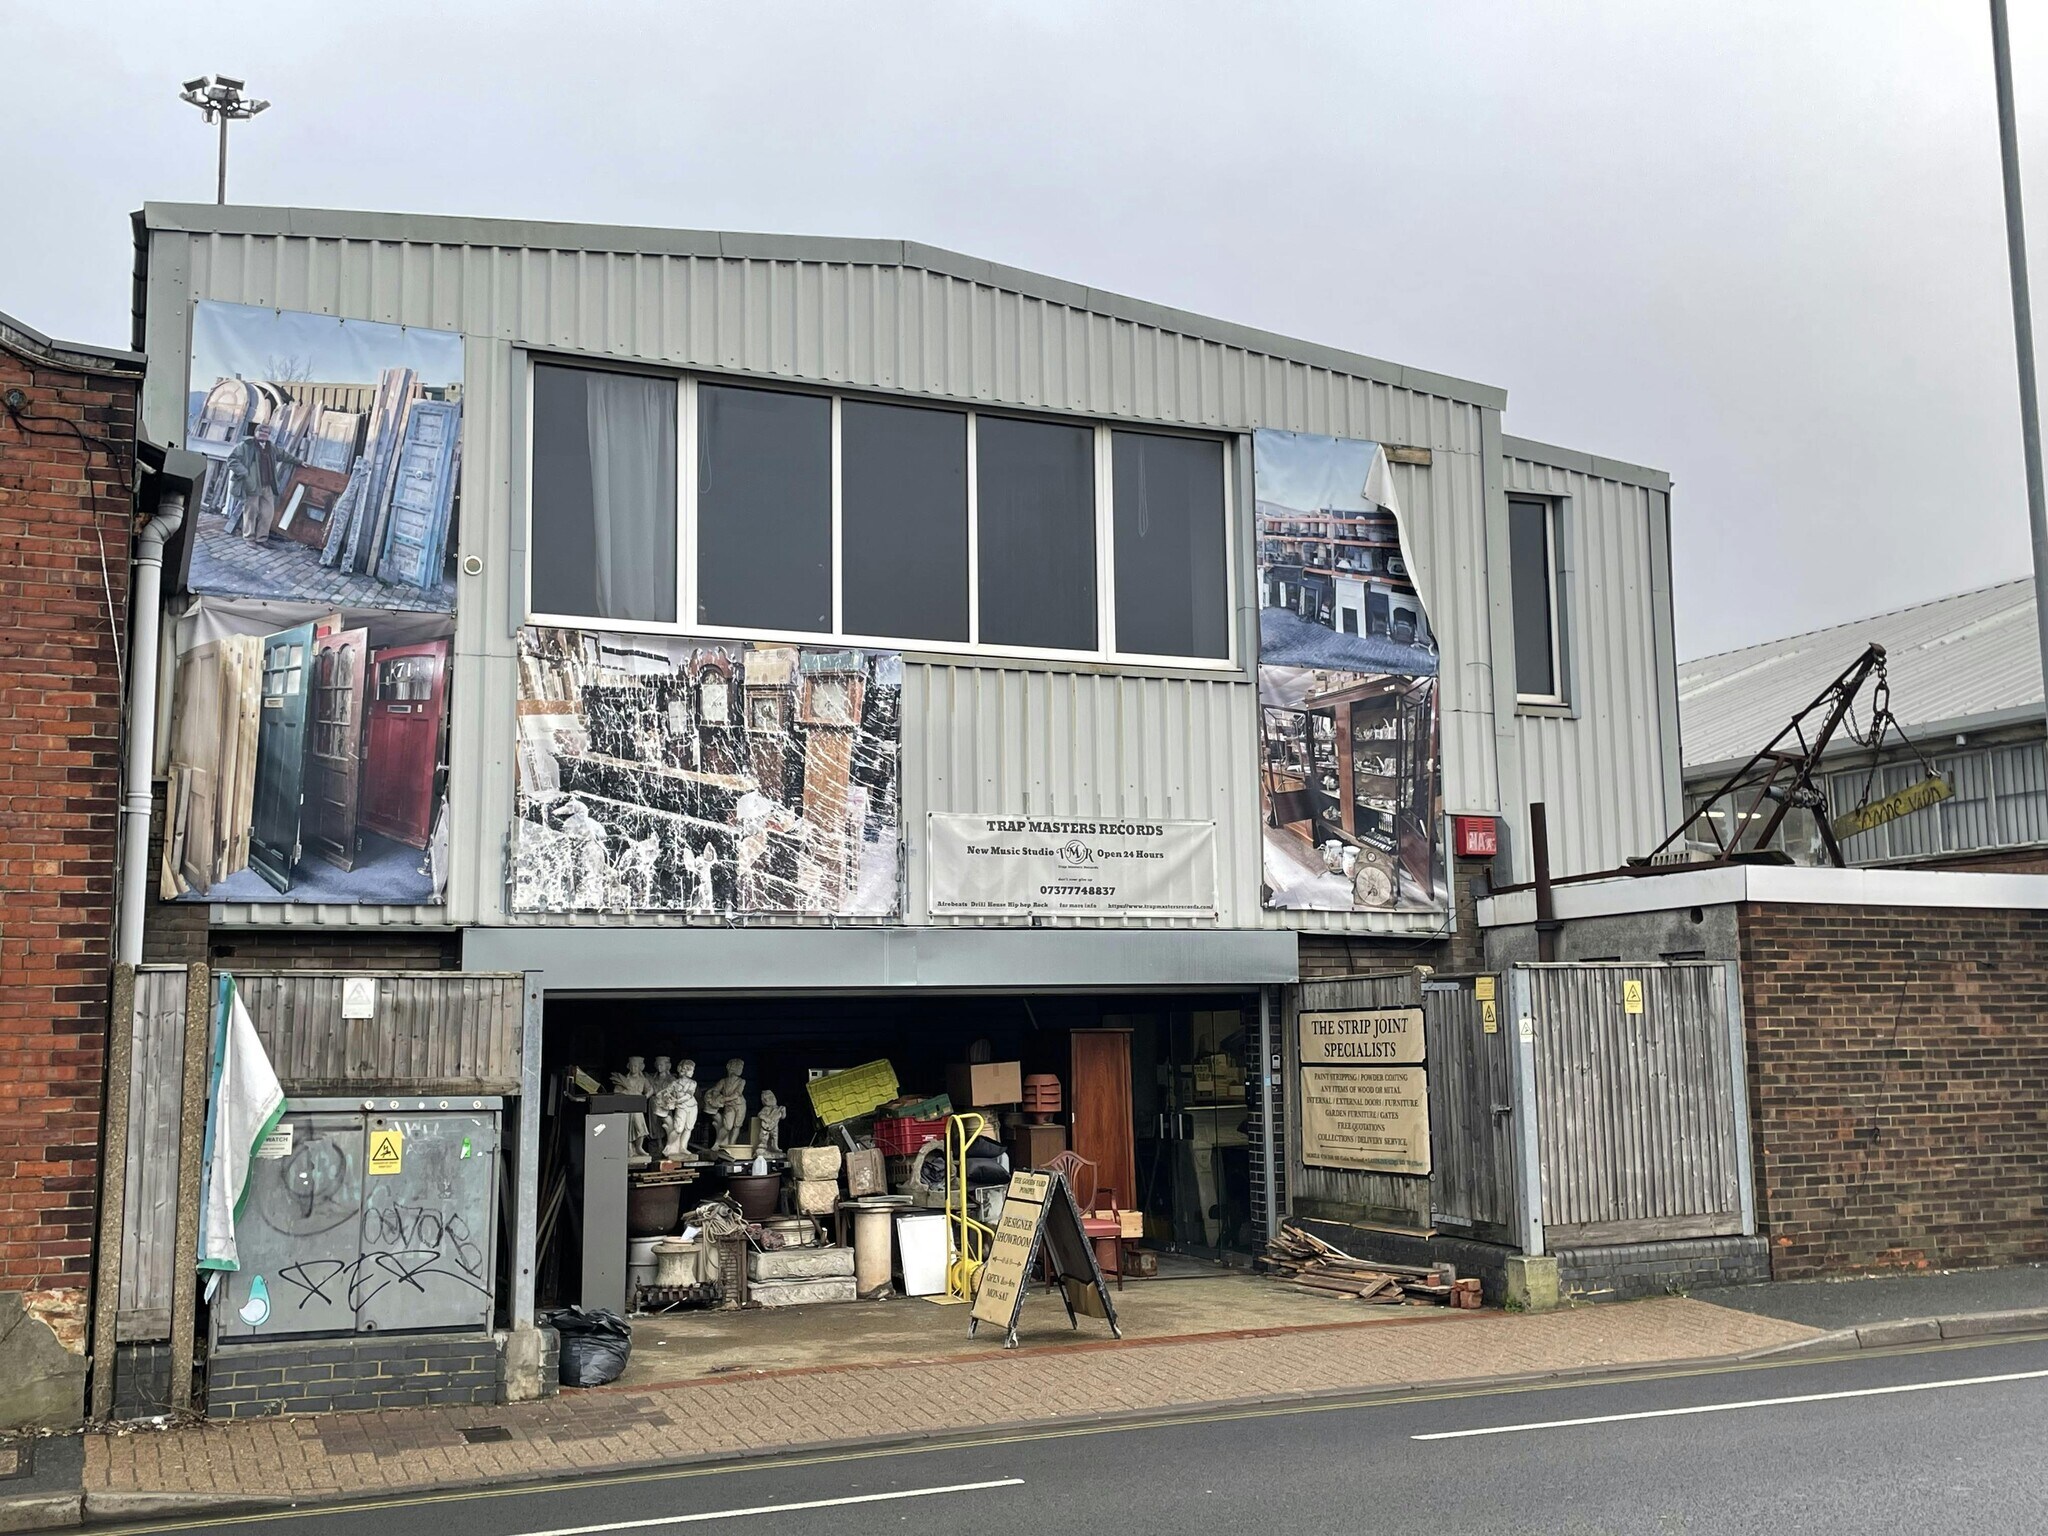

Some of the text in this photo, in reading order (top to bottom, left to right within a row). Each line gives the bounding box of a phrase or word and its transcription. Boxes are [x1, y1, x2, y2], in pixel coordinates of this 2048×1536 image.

[986, 820, 1164, 836] TRAP MASTERS RECORDS
[966, 845, 1055, 856] New Music Studio
[1097, 849, 1164, 859] Open 24 Hours
[1040, 885, 1116, 896] 07377748837
[1311, 1018, 1408, 1039] THE STRIP JOINT
[1324, 1042, 1397, 1058] SPECIALISTS
[1314, 1073, 1329, 1081] PAINT
[1329, 1073, 1357, 1082] STRIPPING
[1360, 1073, 1384, 1081] POWDER
[1321, 1085, 1332, 1093] ANY
[1332, 1085, 1348, 1093] ITEMS
[1357, 1086, 1375, 1094] WOOD
[1375, 1086, 1383, 1094] OR
[1383, 1086, 1401, 1094] METAL
[1306, 1096, 1332, 1105] INTERNAL
[1336, 1097, 1363, 1106] EXTERNAL
[1384, 1099, 1419, 1107] FURNITURE
[1325, 1109, 1347, 1117] GARDEN
[1347, 1110, 1377, 1119] FURNITURE
[1380, 1111, 1399, 1119] GATES
[1337, 1121, 1386, 1132] FREE QUOTATIONS
[1317, 1133, 1354, 1143] COLLECTIONS
[1357, 1135, 1383, 1144] DELIVERY
[1384, 1137, 1408, 1146] SERVICE
[1003, 1216, 1034, 1231] DESIGNER
[996, 1231, 1033, 1248] SHOWROOM
[986, 1272, 1001, 1284] OPEN
